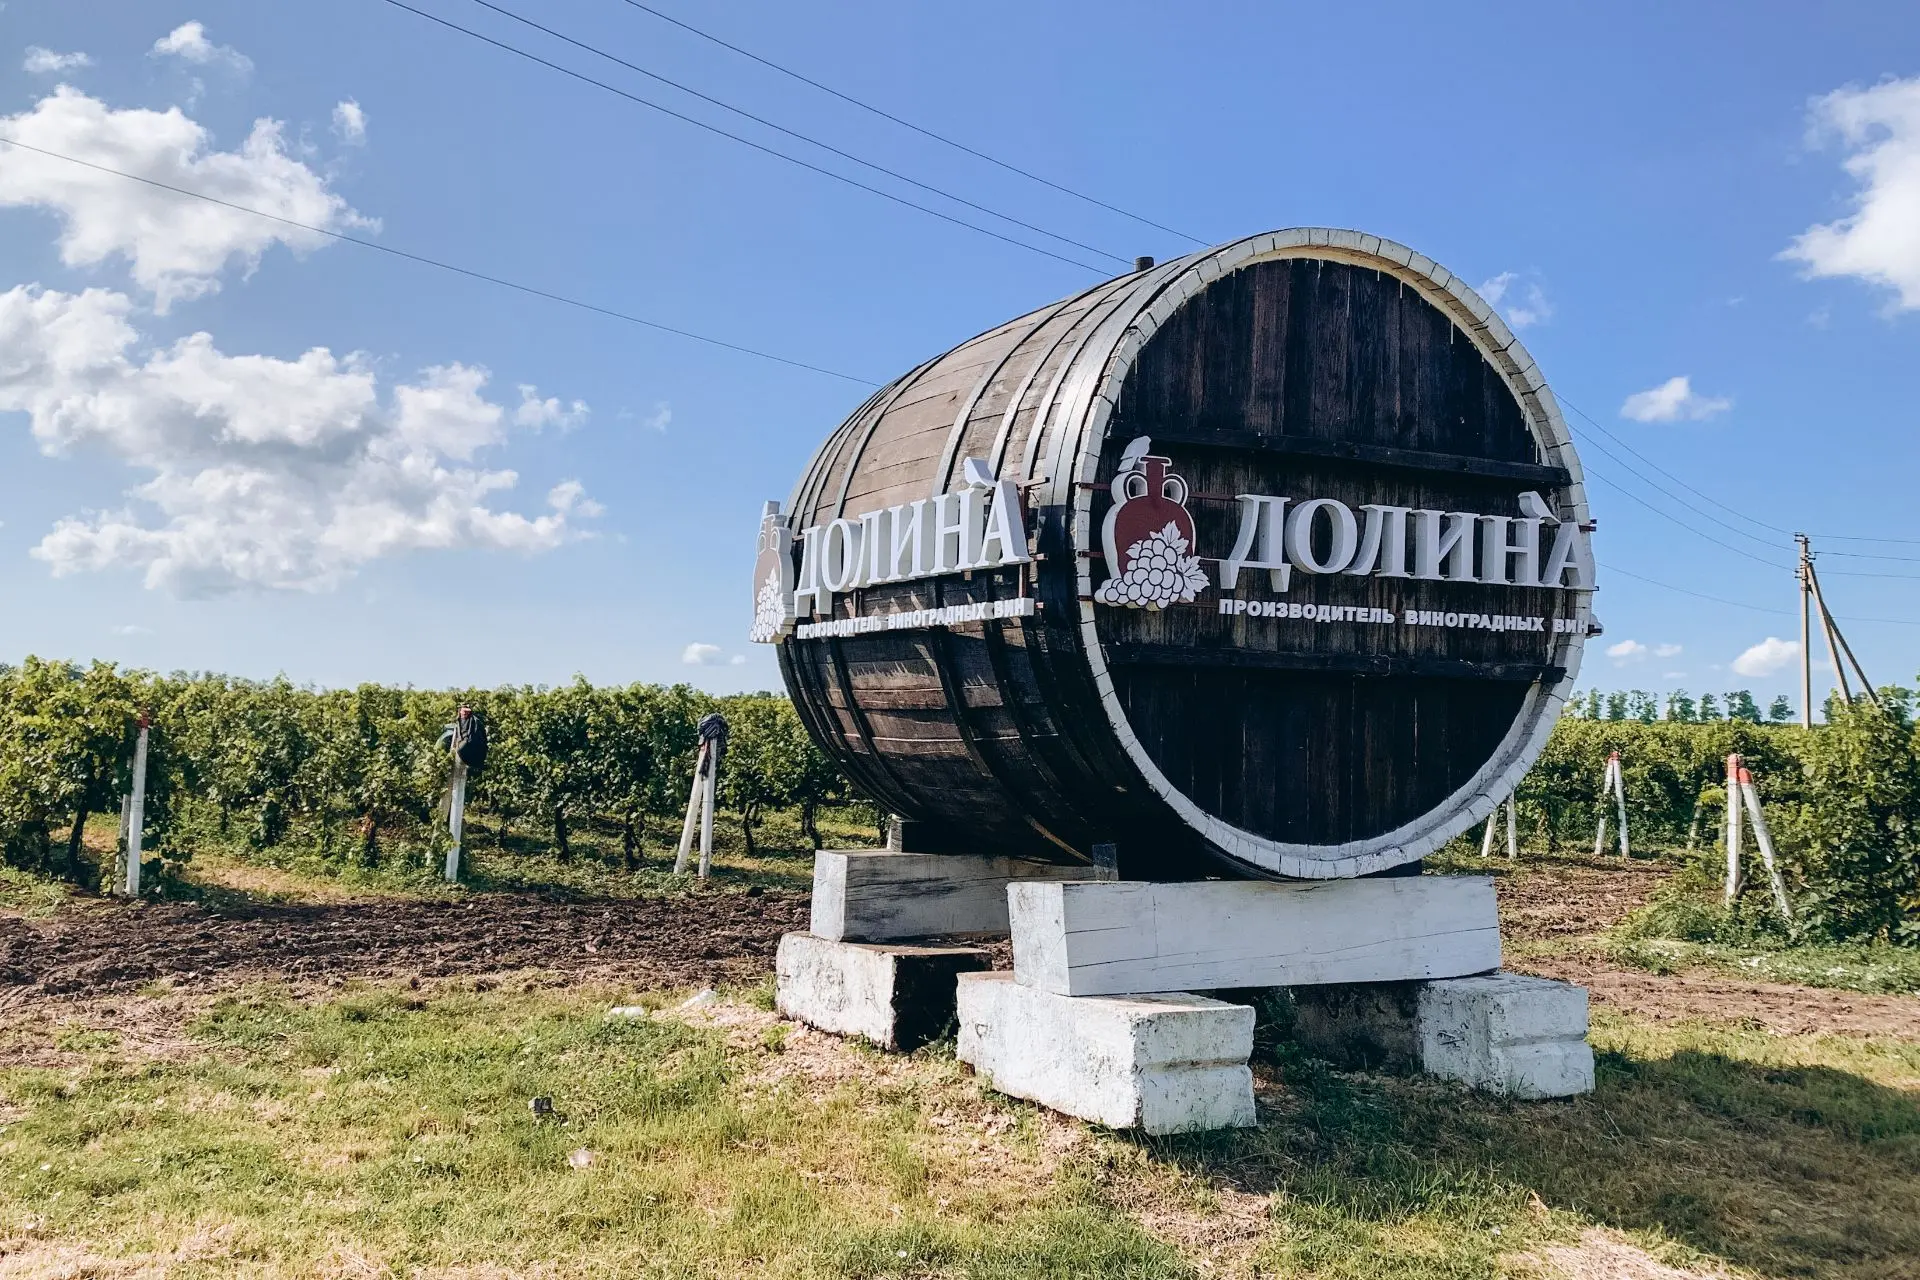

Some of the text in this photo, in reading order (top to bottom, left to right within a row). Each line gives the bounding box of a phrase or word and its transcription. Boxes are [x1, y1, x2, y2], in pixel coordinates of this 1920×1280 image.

[795, 479, 1031, 614] ДОЛИНА
[1218, 493, 1596, 593] ДОЛИНА
[797, 598, 1030, 639] ПРОИЗВОДИТЕЛЬ ВИНОГРАДНЫХ ВИН
[1218, 598, 1589, 634] ПРОИЗВОДИТЕЛЬ ВИНОГРАДНЫХ ВИН
